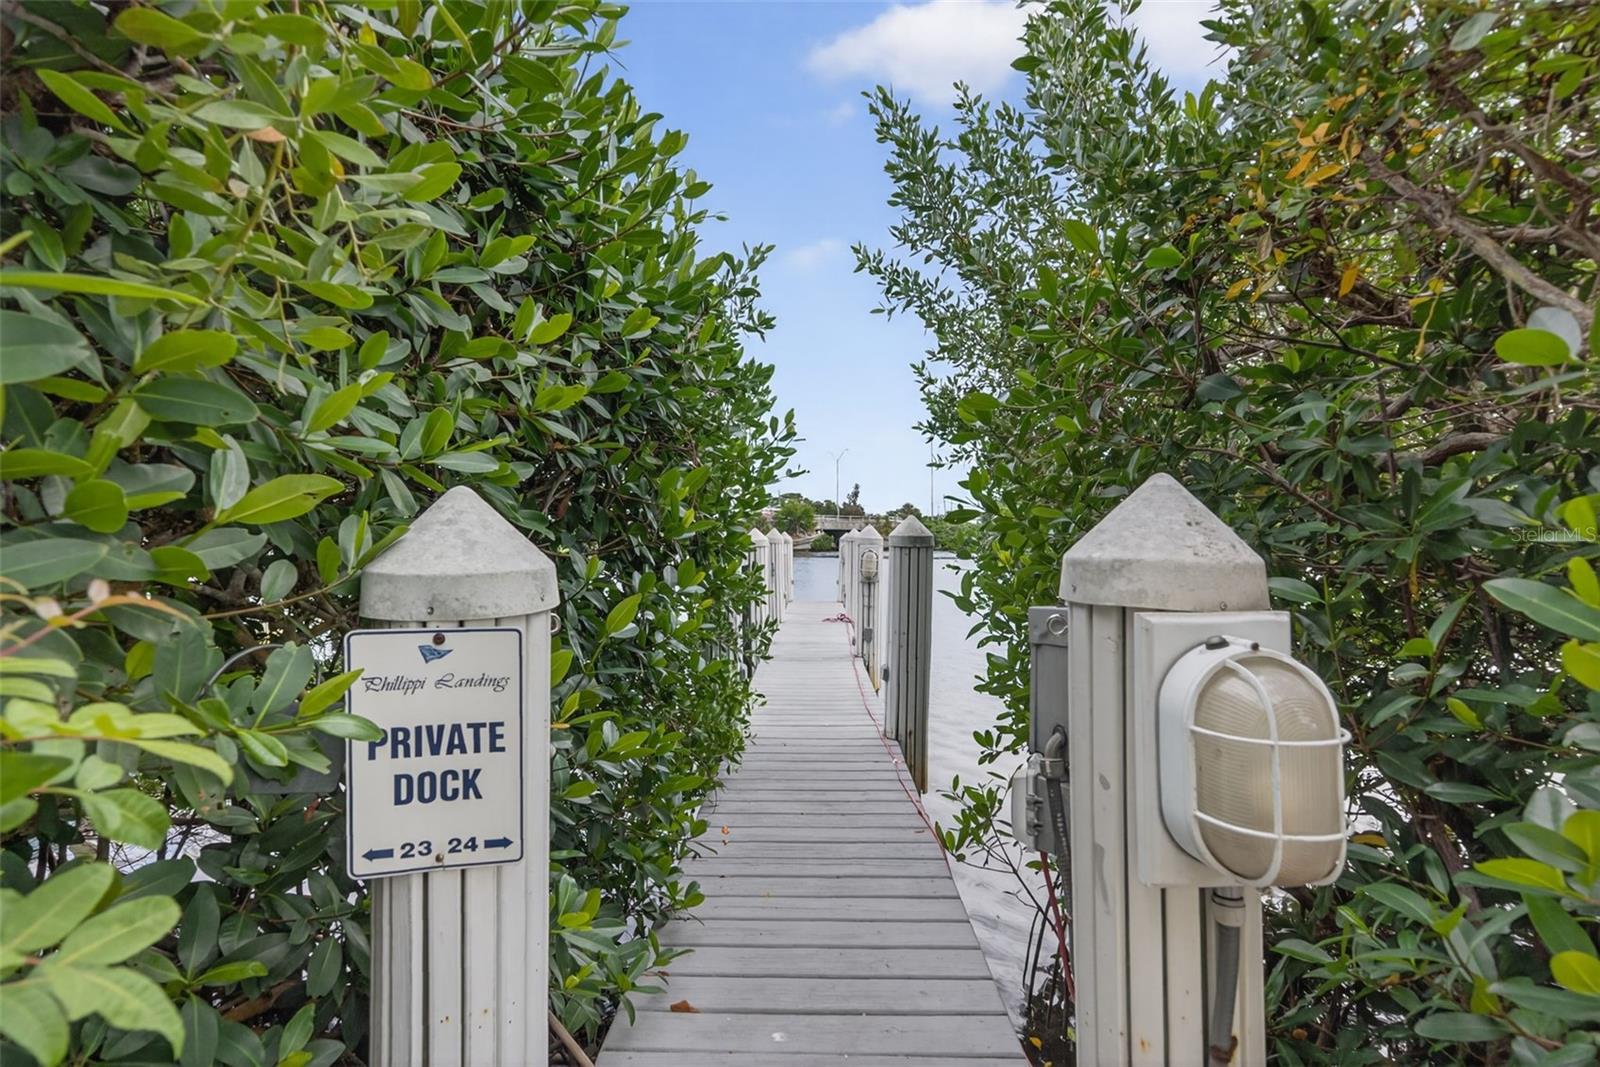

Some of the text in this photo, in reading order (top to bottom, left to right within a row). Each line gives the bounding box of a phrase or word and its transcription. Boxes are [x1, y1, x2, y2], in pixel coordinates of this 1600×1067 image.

[361, 672, 510, 695] Phillippi Landings
[367, 721, 506, 761] PRIVATE
[393, 768, 483, 806] DOCK
[400, 836, 478, 859] 23 24
